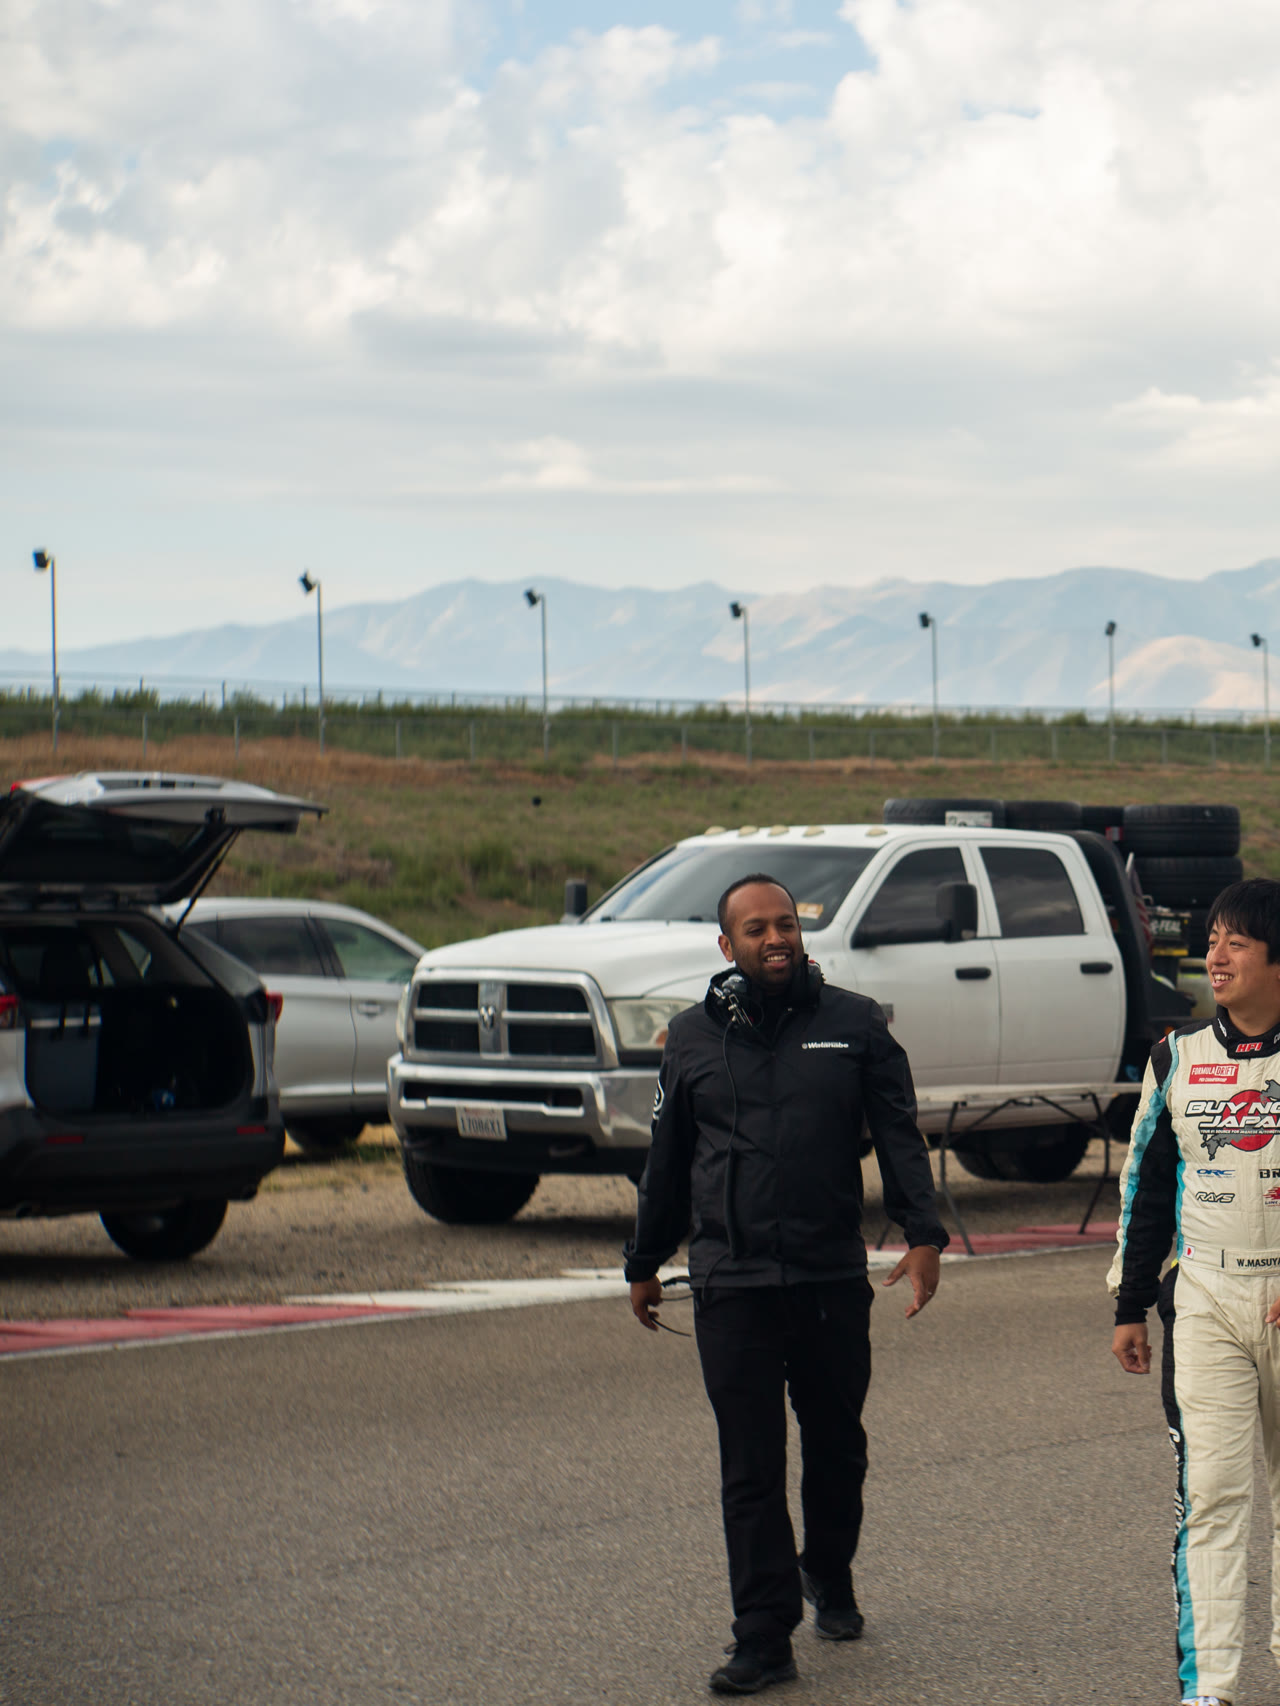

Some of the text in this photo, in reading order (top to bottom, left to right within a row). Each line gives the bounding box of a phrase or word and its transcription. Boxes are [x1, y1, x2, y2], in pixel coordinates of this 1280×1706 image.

[1235, 1042, 1263, 1053] HPI
[1191, 1065, 1237, 1076] FORMULA DRIFT
[1186, 1101, 1248, 1115] BUY
[1195, 1192, 1236, 1203] RAYS
